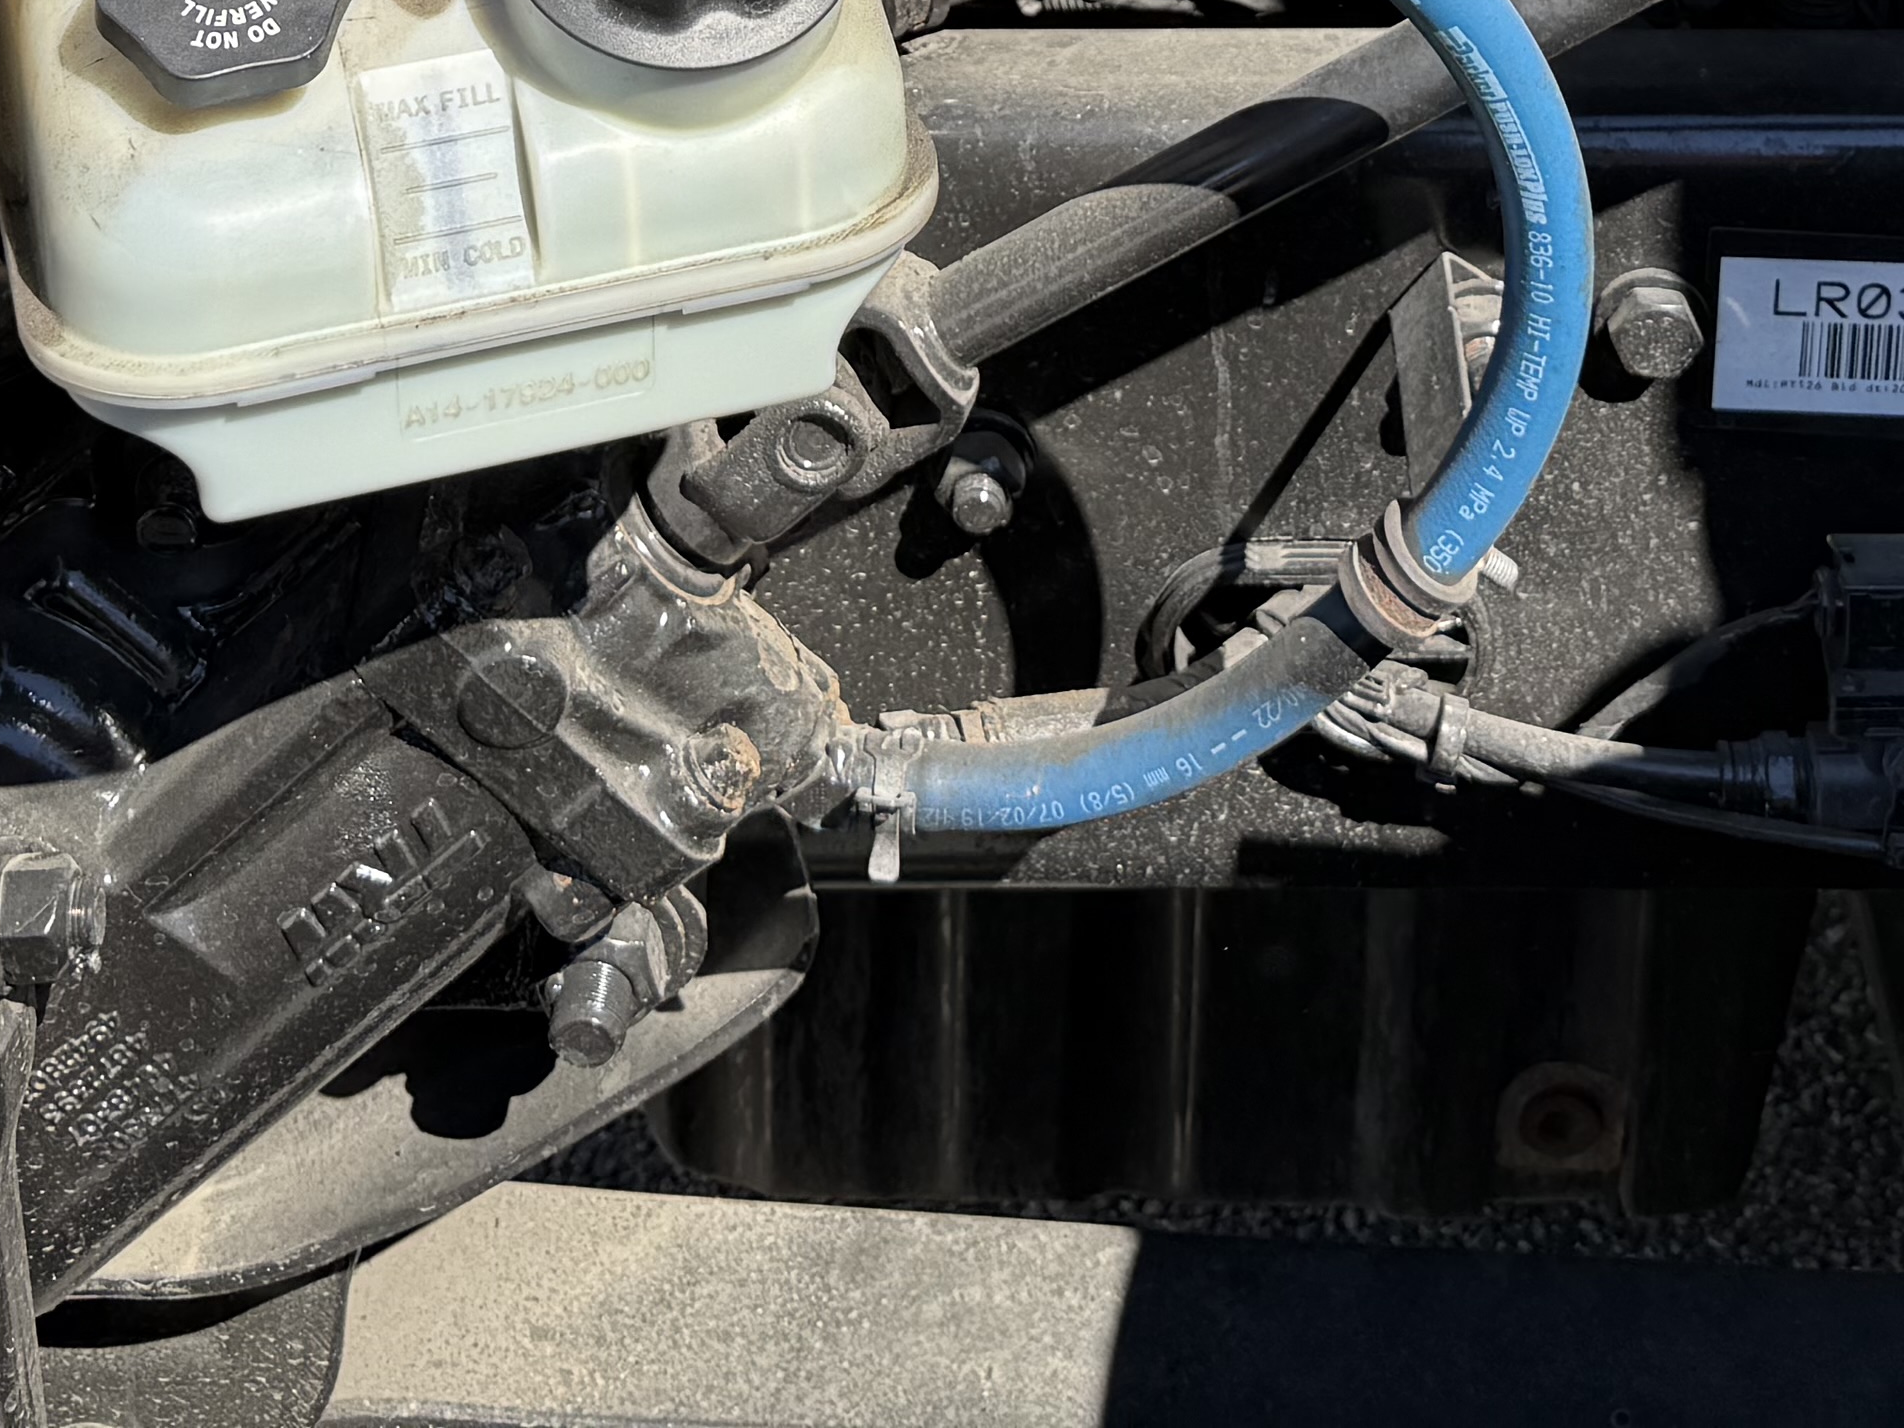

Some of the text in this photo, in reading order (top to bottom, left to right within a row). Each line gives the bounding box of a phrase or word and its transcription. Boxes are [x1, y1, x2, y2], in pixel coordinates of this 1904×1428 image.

[190, 17, 281, 49] DO NOT
[372, 82, 501, 122] MAX FILL
[398, 236, 526, 279] MIN COLD
[1423, 230, 1554, 575] 836-10 HI-TEMP MPa (350
[1080, 753, 1203, 813] 16 mm (5/8)
